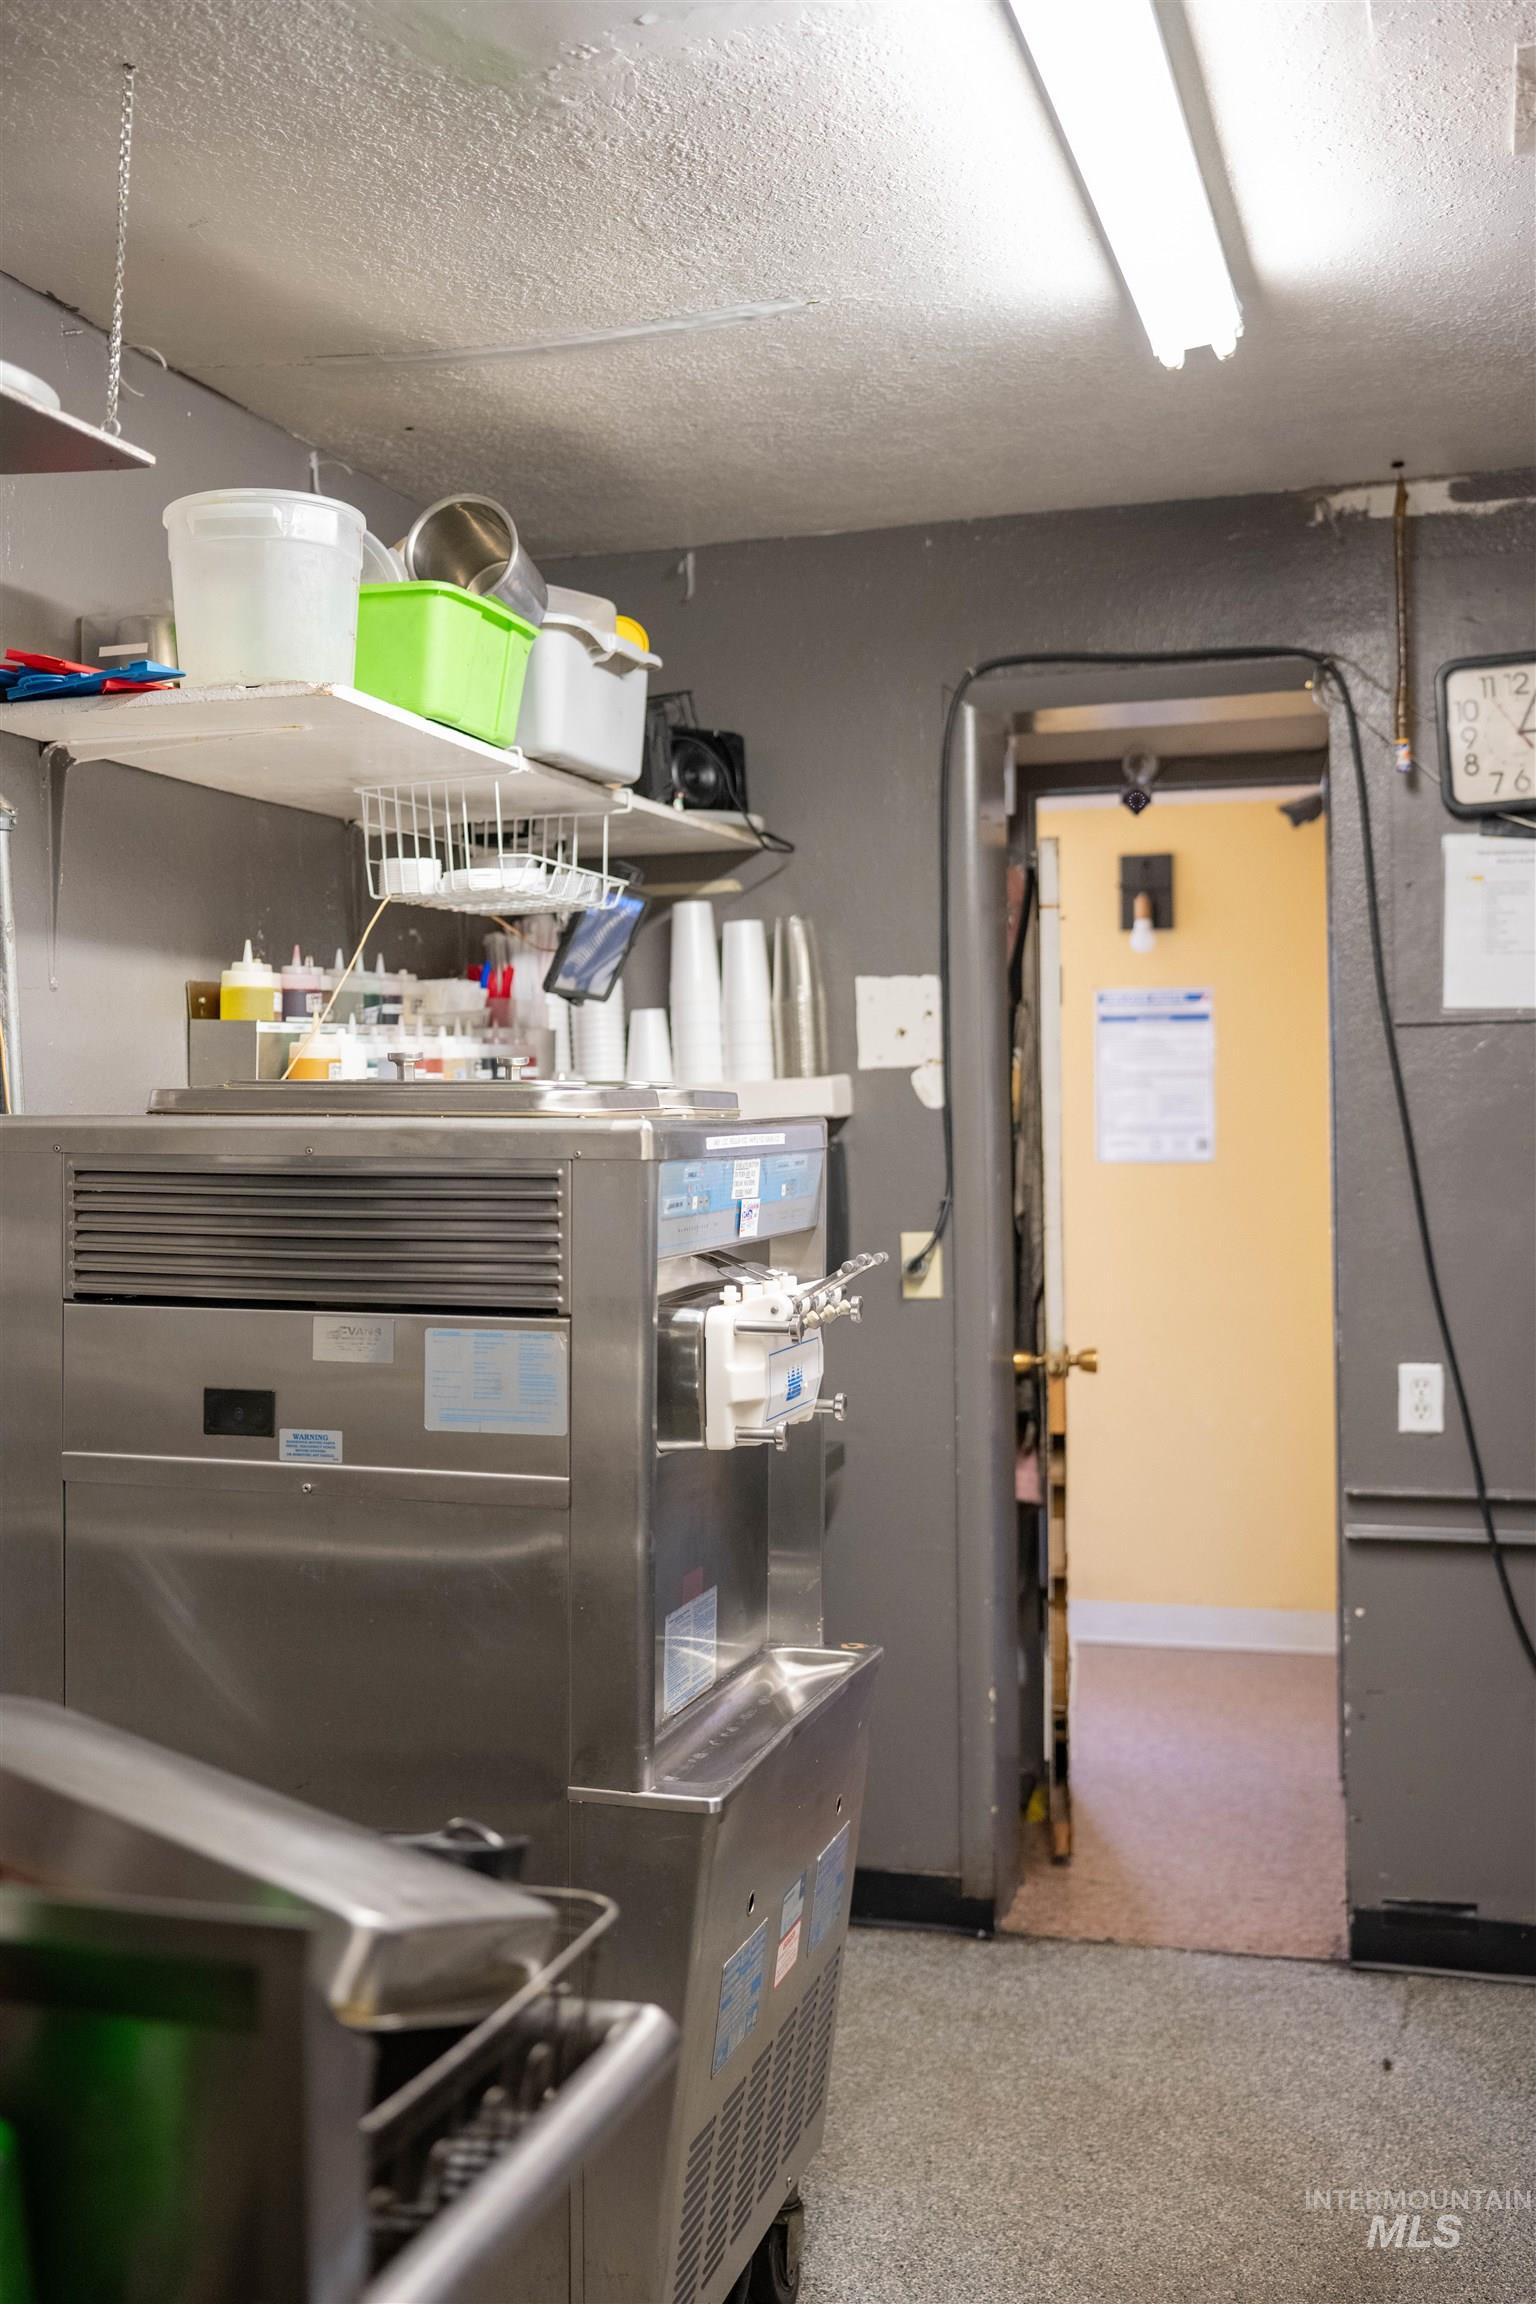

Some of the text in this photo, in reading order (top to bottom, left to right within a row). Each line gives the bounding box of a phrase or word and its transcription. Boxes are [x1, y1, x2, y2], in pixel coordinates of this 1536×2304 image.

[1480, 676, 1496, 698] 11
[1503, 672, 1530, 695] 12
[1453, 699, 1479, 722] 10
[1460, 726, 1478, 749] 9
[1464, 753, 1480, 776] 8
[1488, 771, 1504, 795] 7
[1514, 769, 1532, 793] 6
[292, 1433, 329, 1441] WARNING
